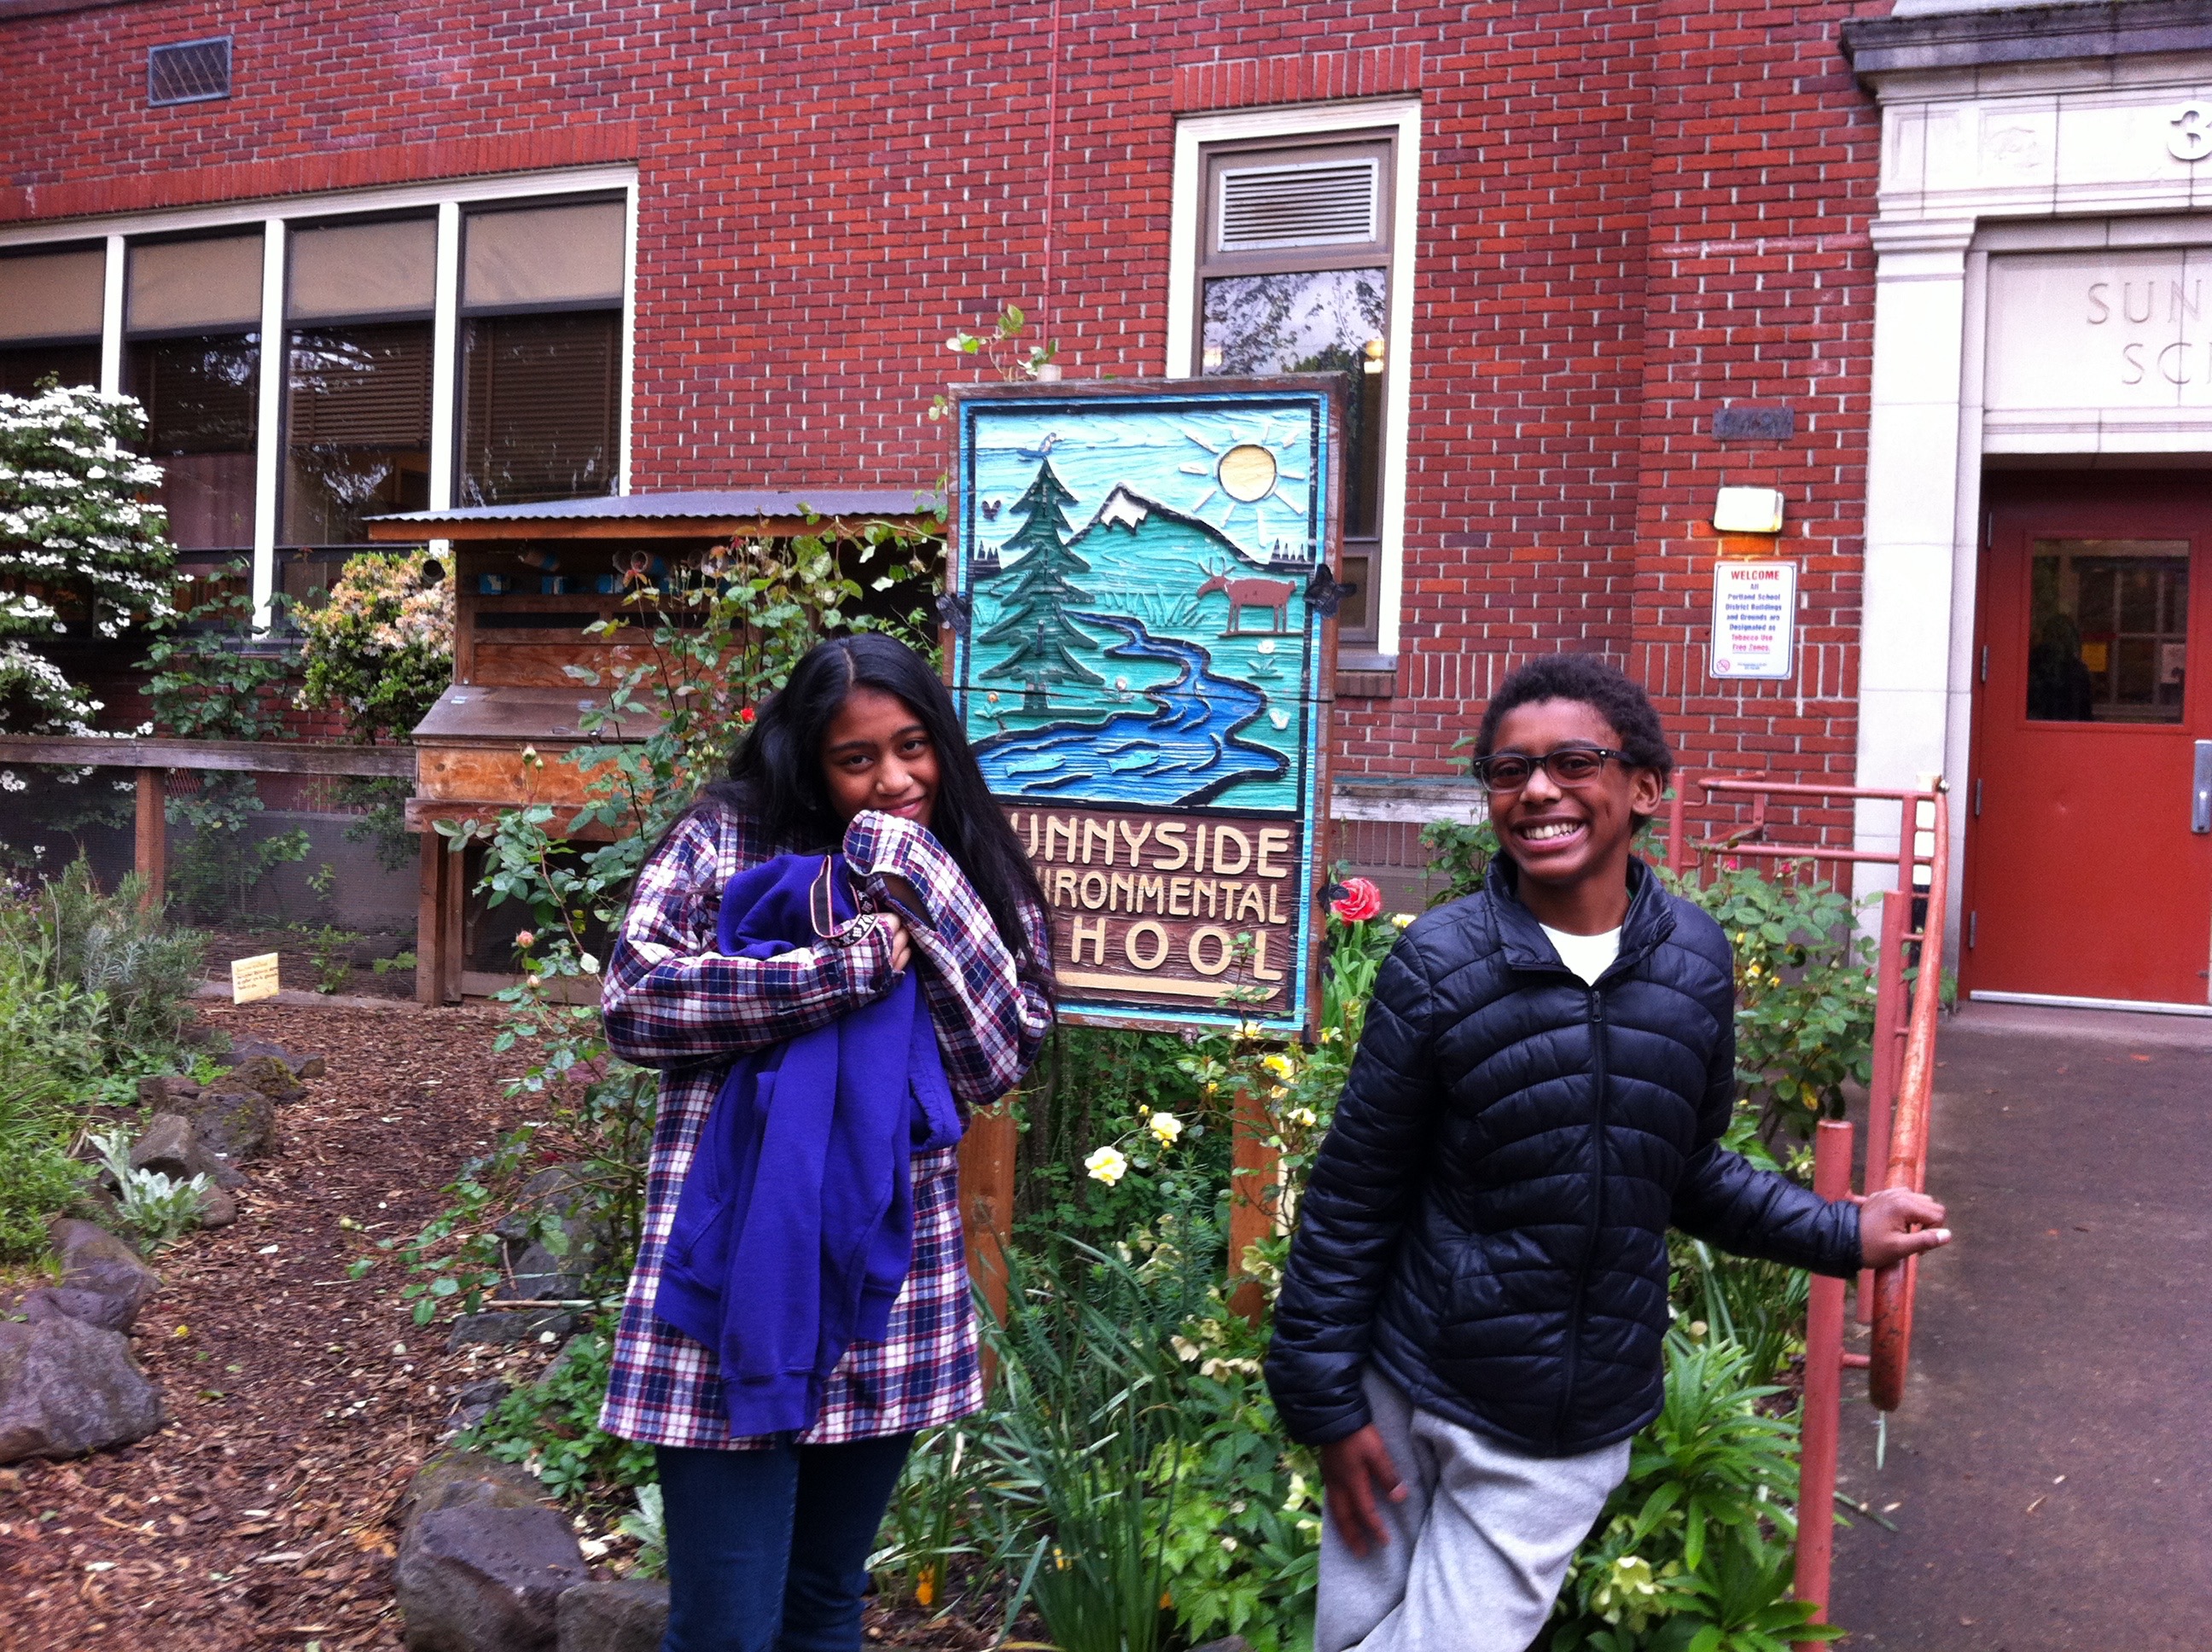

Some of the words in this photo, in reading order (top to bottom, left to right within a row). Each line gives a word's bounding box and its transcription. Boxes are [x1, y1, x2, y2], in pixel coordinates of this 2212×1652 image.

[2122, 341, 2212, 386] SC
[1731, 570, 1780, 580] WELCOME
[1035, 865, 1288, 925] IRONMENTAL
